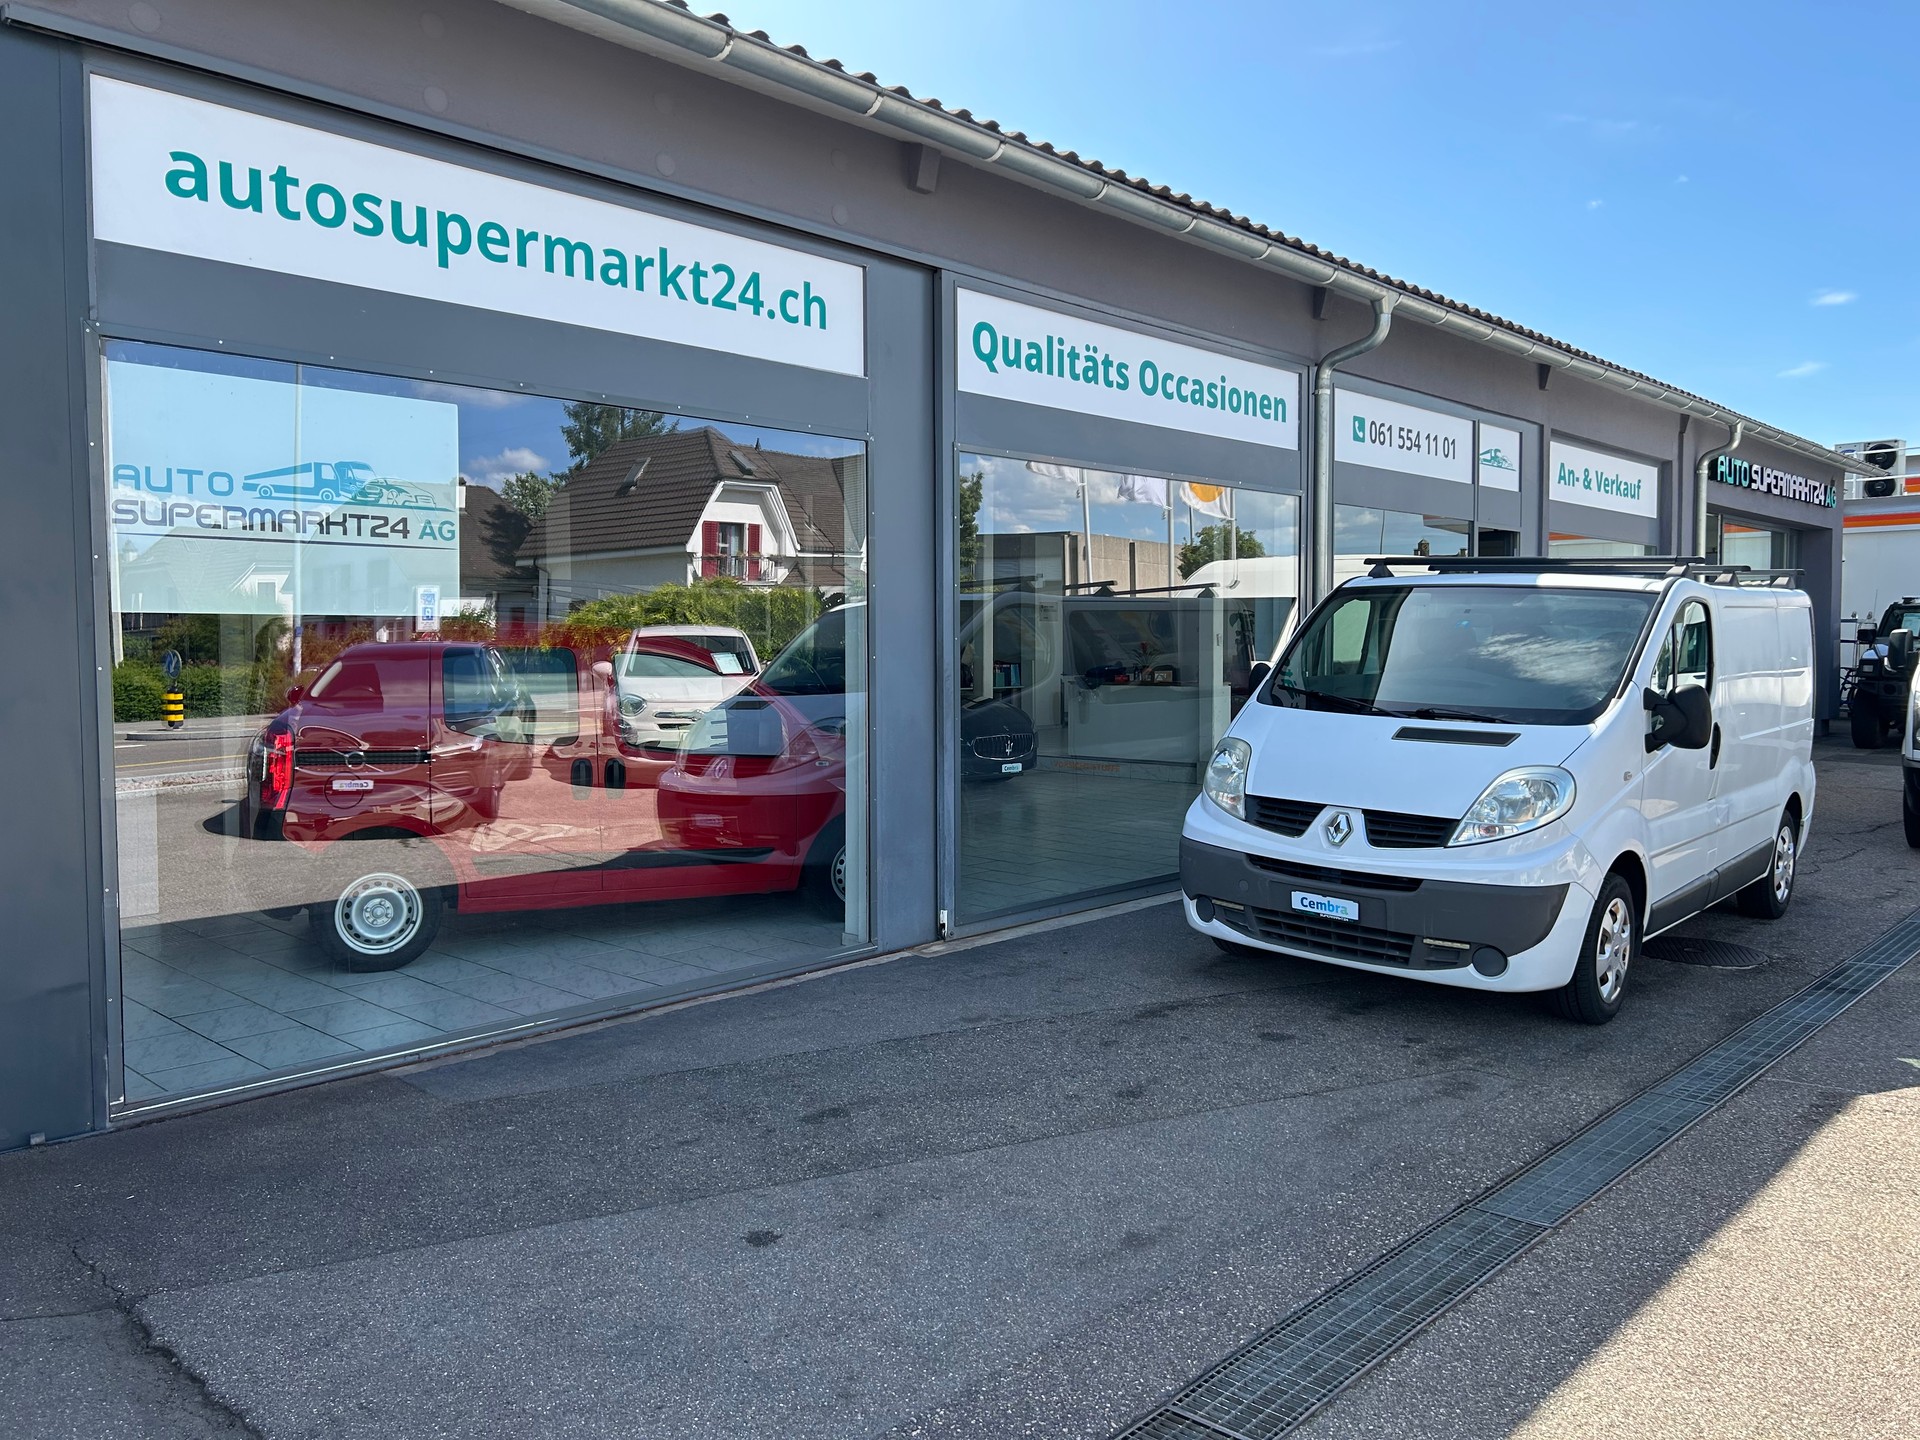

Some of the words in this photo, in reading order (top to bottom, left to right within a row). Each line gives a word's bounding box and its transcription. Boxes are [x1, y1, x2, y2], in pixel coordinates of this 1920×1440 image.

[164, 150, 828, 331] autosupermarkt24.ch
[972, 321, 1130, 391] Qualitäts
[1138, 360, 1287, 423] Occasionen
[1369, 420, 1393, 447] 061
[1398, 426, 1422, 453] 554
[1425, 433, 1438, 456] 11
[1443, 436, 1456, 460] 01
[113, 463, 234, 497] AUTO
[1557, 462, 1580, 487] An-
[1582, 467, 1592, 491] &
[1595, 470, 1642, 500] Verkauf
[1717, 455, 1750, 488] AUTO
[1751, 464, 1825, 506] SUPERMARKT24
[1825, 484, 1837, 509] AG
[111, 499, 411, 540] SUPERMARKT24
[417, 519, 456, 542] AG
[1300, 896, 1349, 916] Cembra
